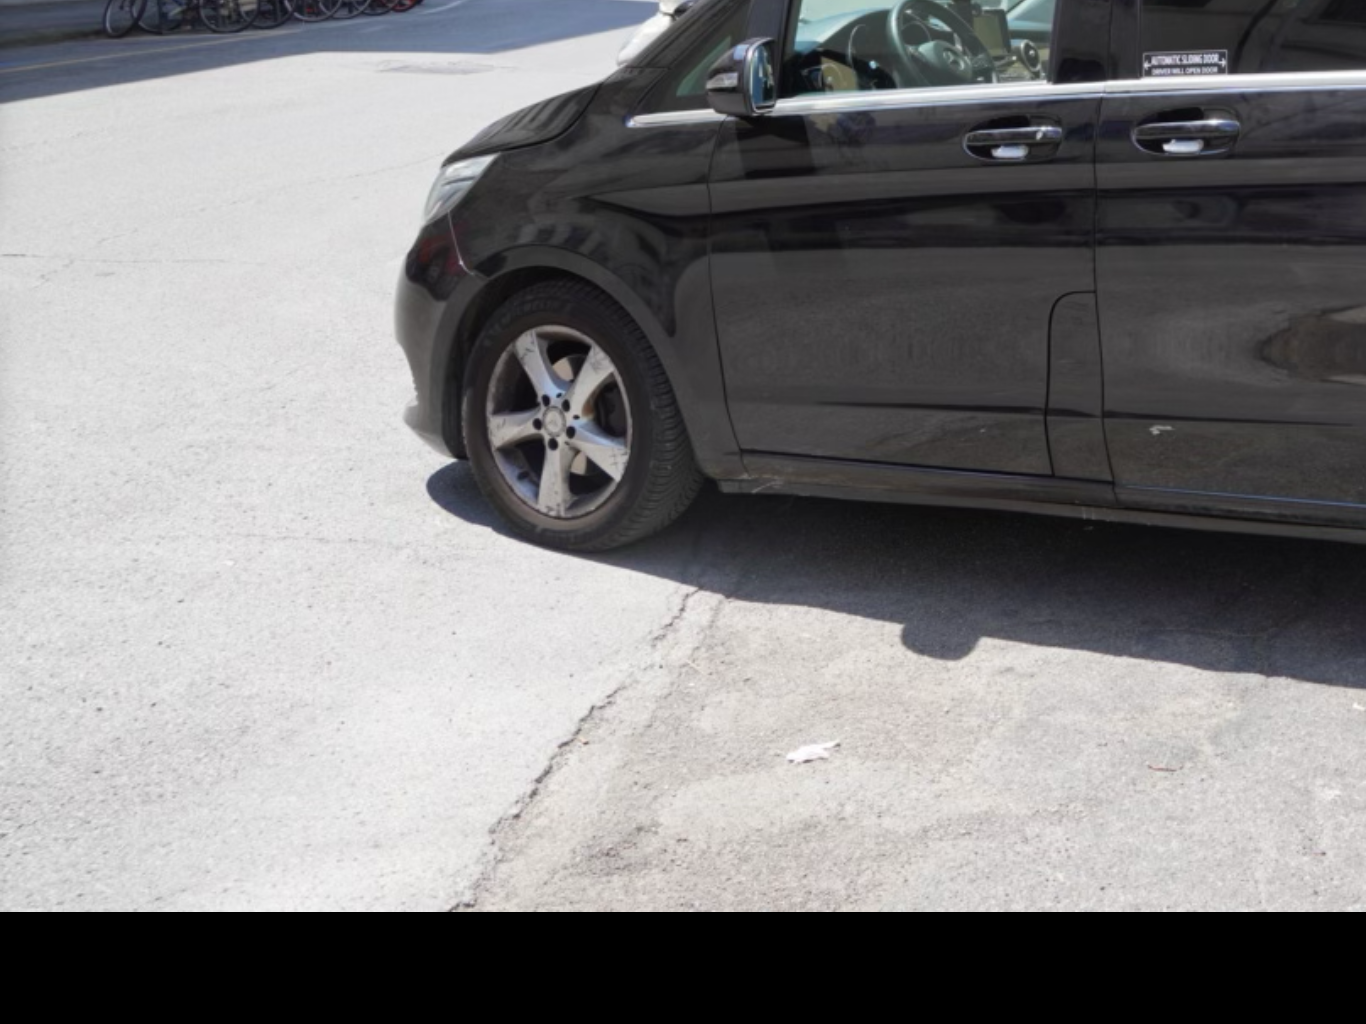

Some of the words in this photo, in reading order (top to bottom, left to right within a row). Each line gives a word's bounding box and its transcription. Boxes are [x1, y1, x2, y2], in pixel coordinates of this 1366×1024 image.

[1151, 55, 1180, 66] AUTOMATIC
[1203, 53, 1219, 63] DOOR
[1151, 67, 1172, 76] DRIVER
[1202, 66, 1218, 74] DOOR
